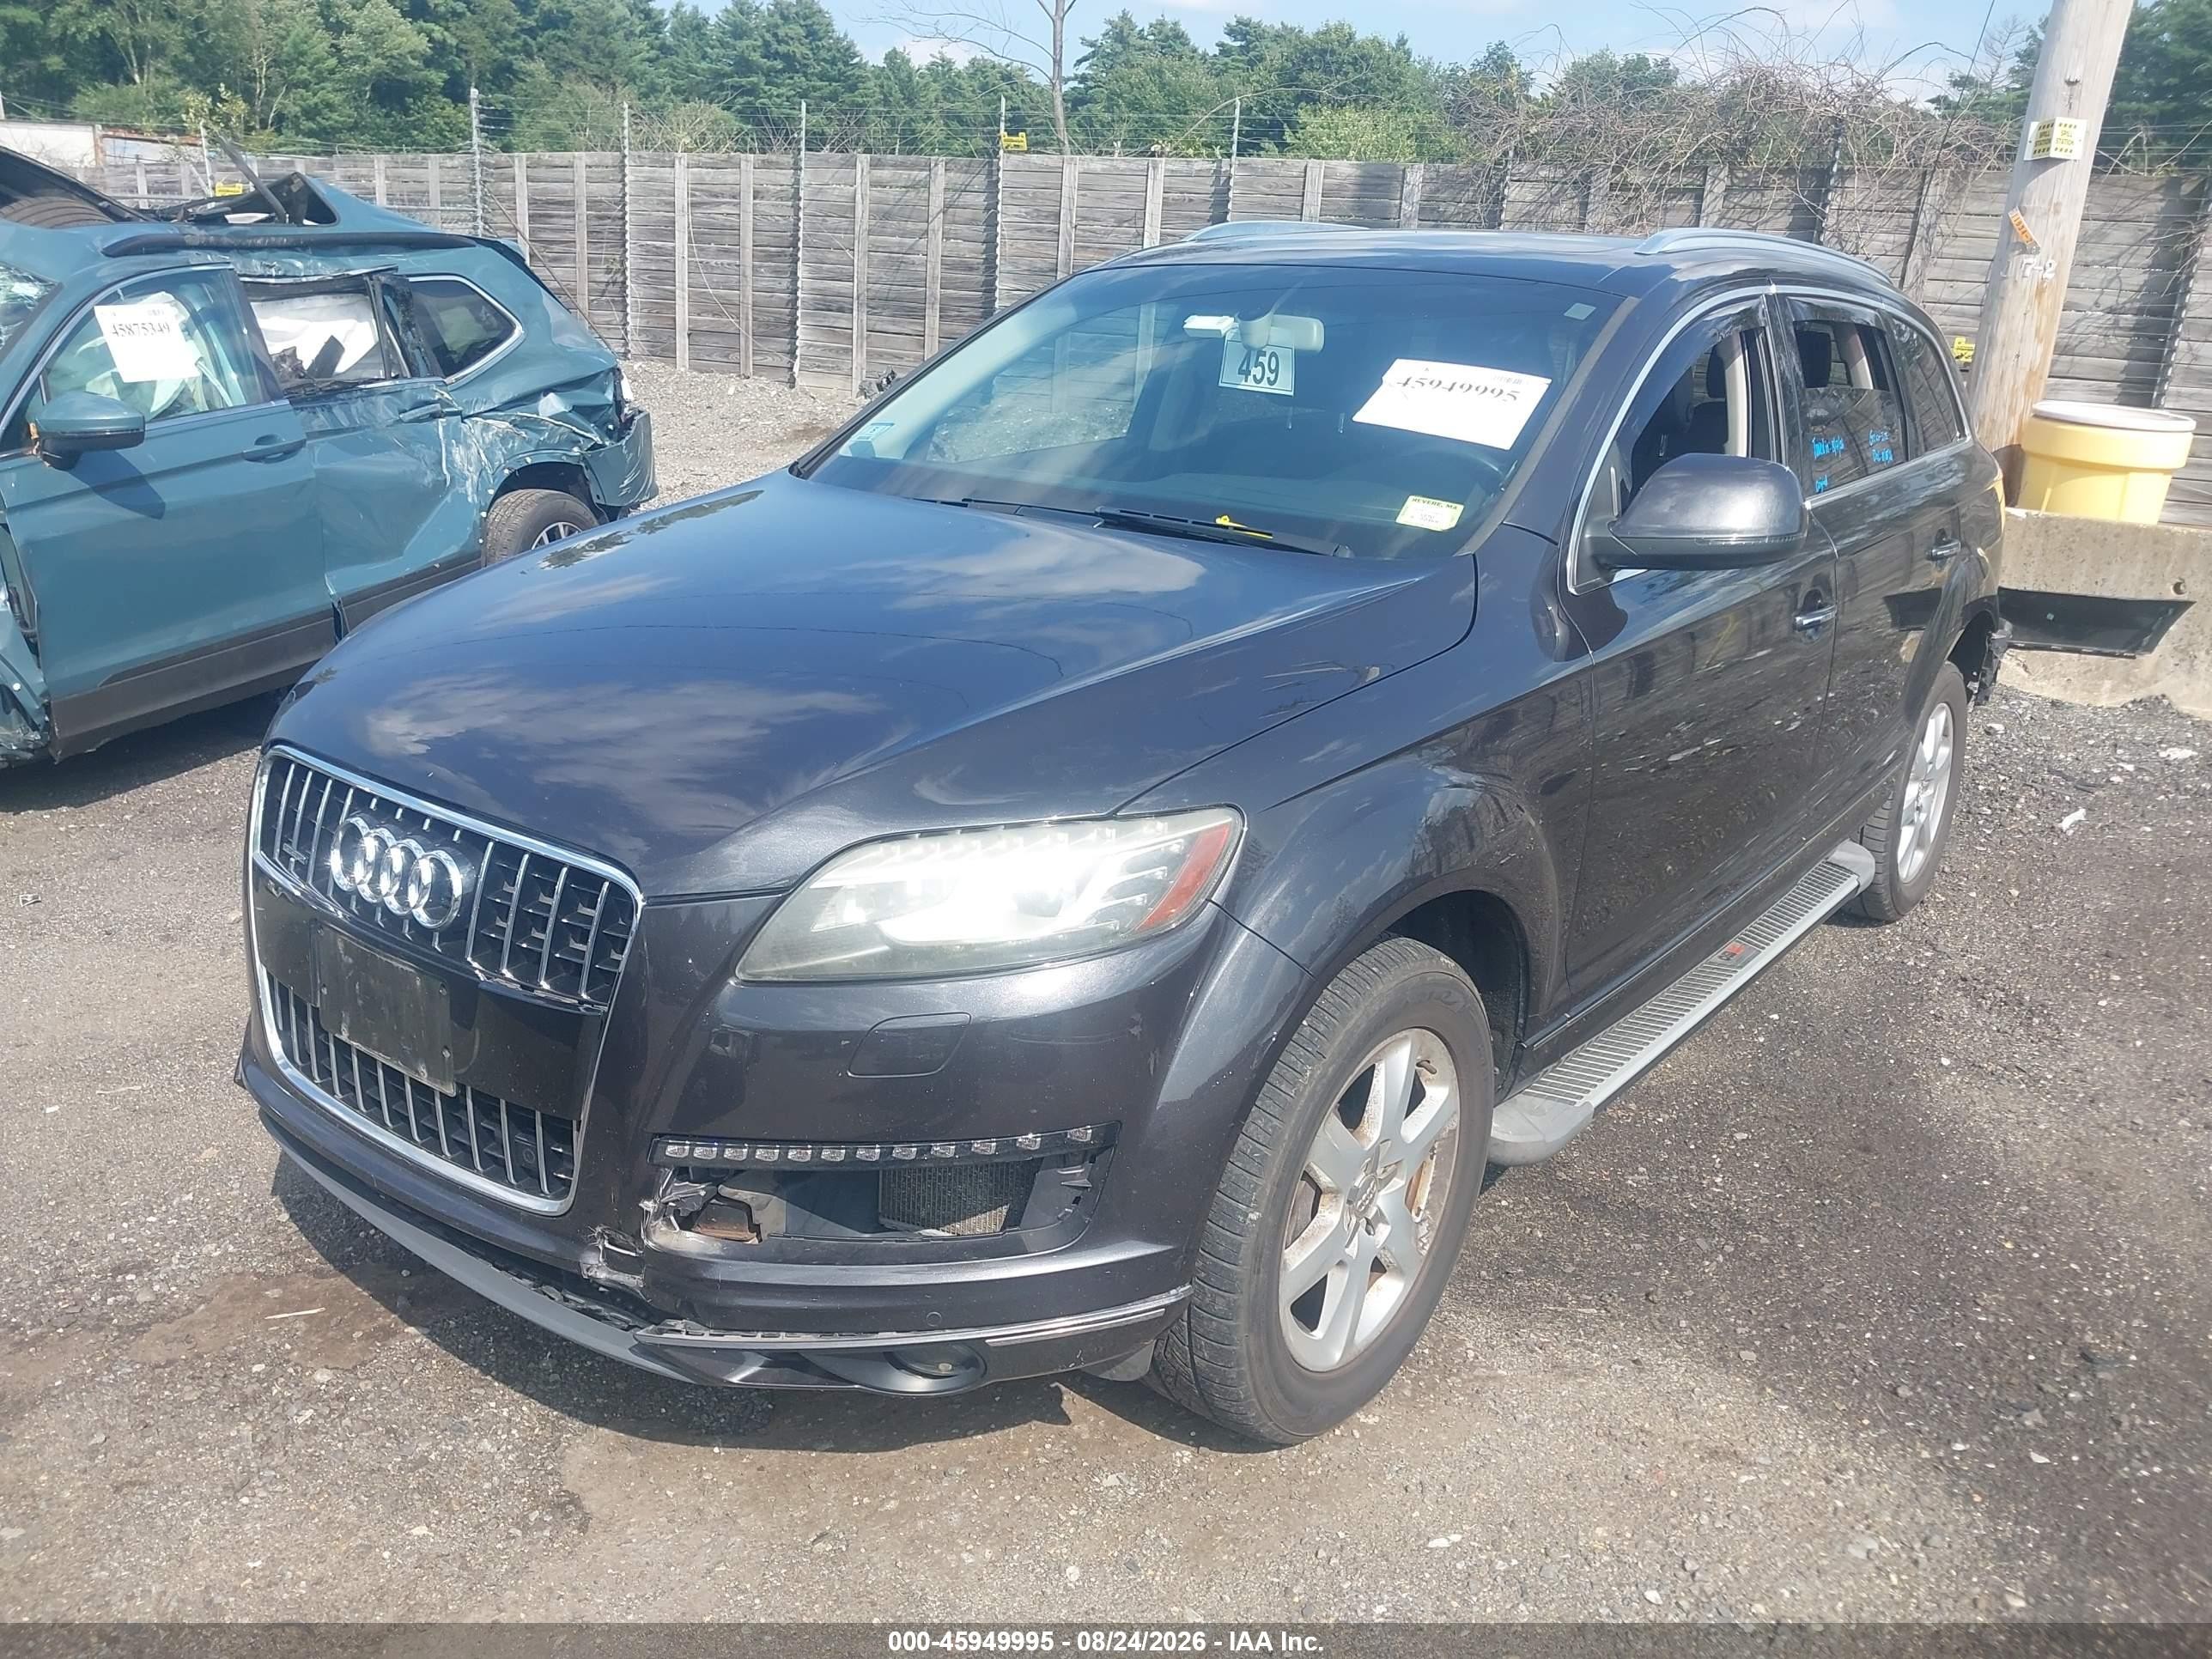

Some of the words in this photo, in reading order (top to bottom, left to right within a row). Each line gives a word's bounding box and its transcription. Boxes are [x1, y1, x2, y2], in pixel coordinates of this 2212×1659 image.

[111, 322, 171, 337] 45875349
[1237, 349, 1279, 386] 459
[1396, 376, 1521, 402] 45949995
